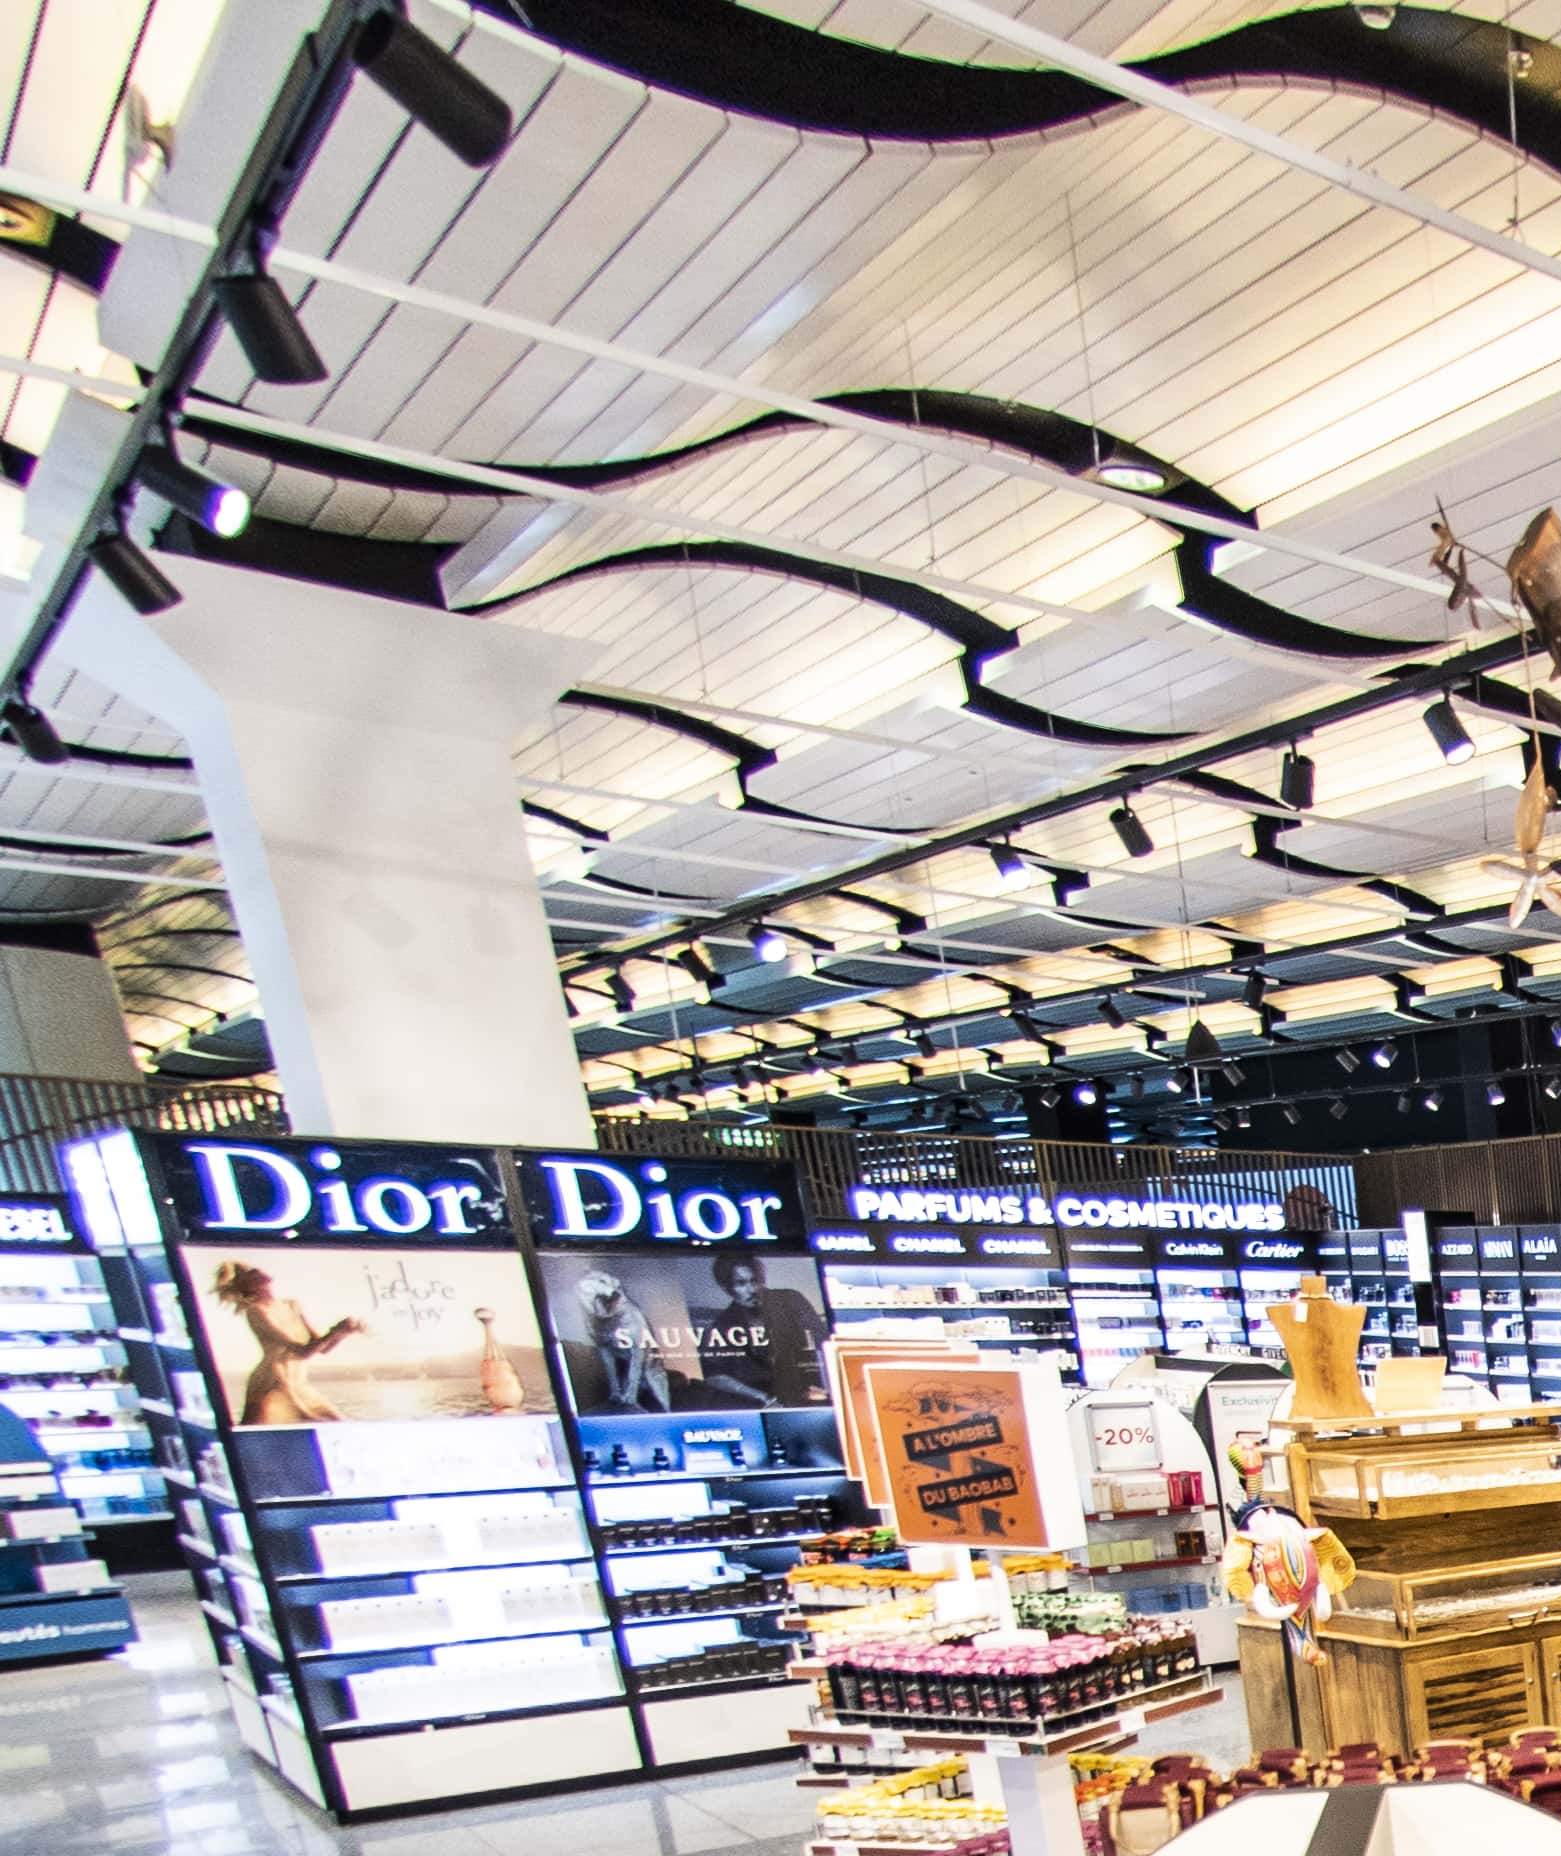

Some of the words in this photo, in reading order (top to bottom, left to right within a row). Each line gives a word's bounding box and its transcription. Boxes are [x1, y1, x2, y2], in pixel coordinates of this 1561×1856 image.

[186, 1144, 482, 1235] Dior
[541, 1160, 782, 1241] Dior
[854, 1190, 1024, 1223] PARFUMS
[1028, 1197, 1054, 1225] &
[1057, 1198, 1285, 1230] COSMETIQUES
[1246, 1241, 1304, 1258] Cartier
[615, 1326, 770, 1349] SAUVAGE
[1095, 1427, 1154, 1446] -20%
[922, 1489, 946, 1505] DU
[946, 1475, 1014, 1501] BAOBAB
